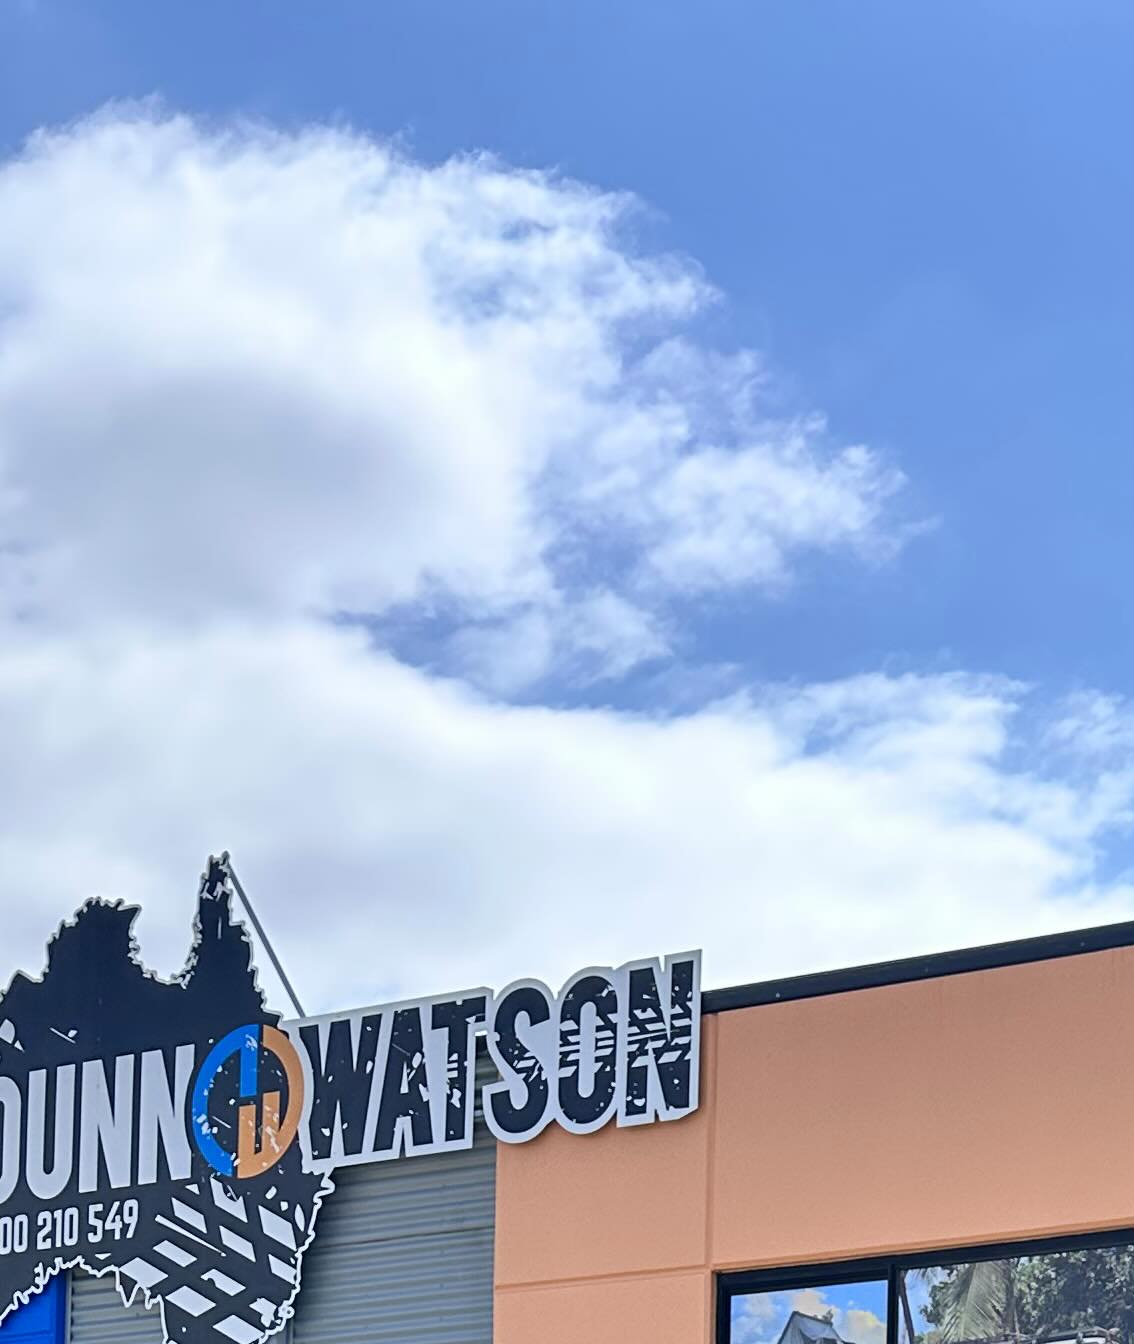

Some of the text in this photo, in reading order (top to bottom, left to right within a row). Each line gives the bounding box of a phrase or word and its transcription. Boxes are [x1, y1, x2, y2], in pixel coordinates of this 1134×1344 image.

[298, 960, 694, 1161] WATSON
[36, 1207, 79, 1250] 210
[88, 1199, 139, 1243] 549
